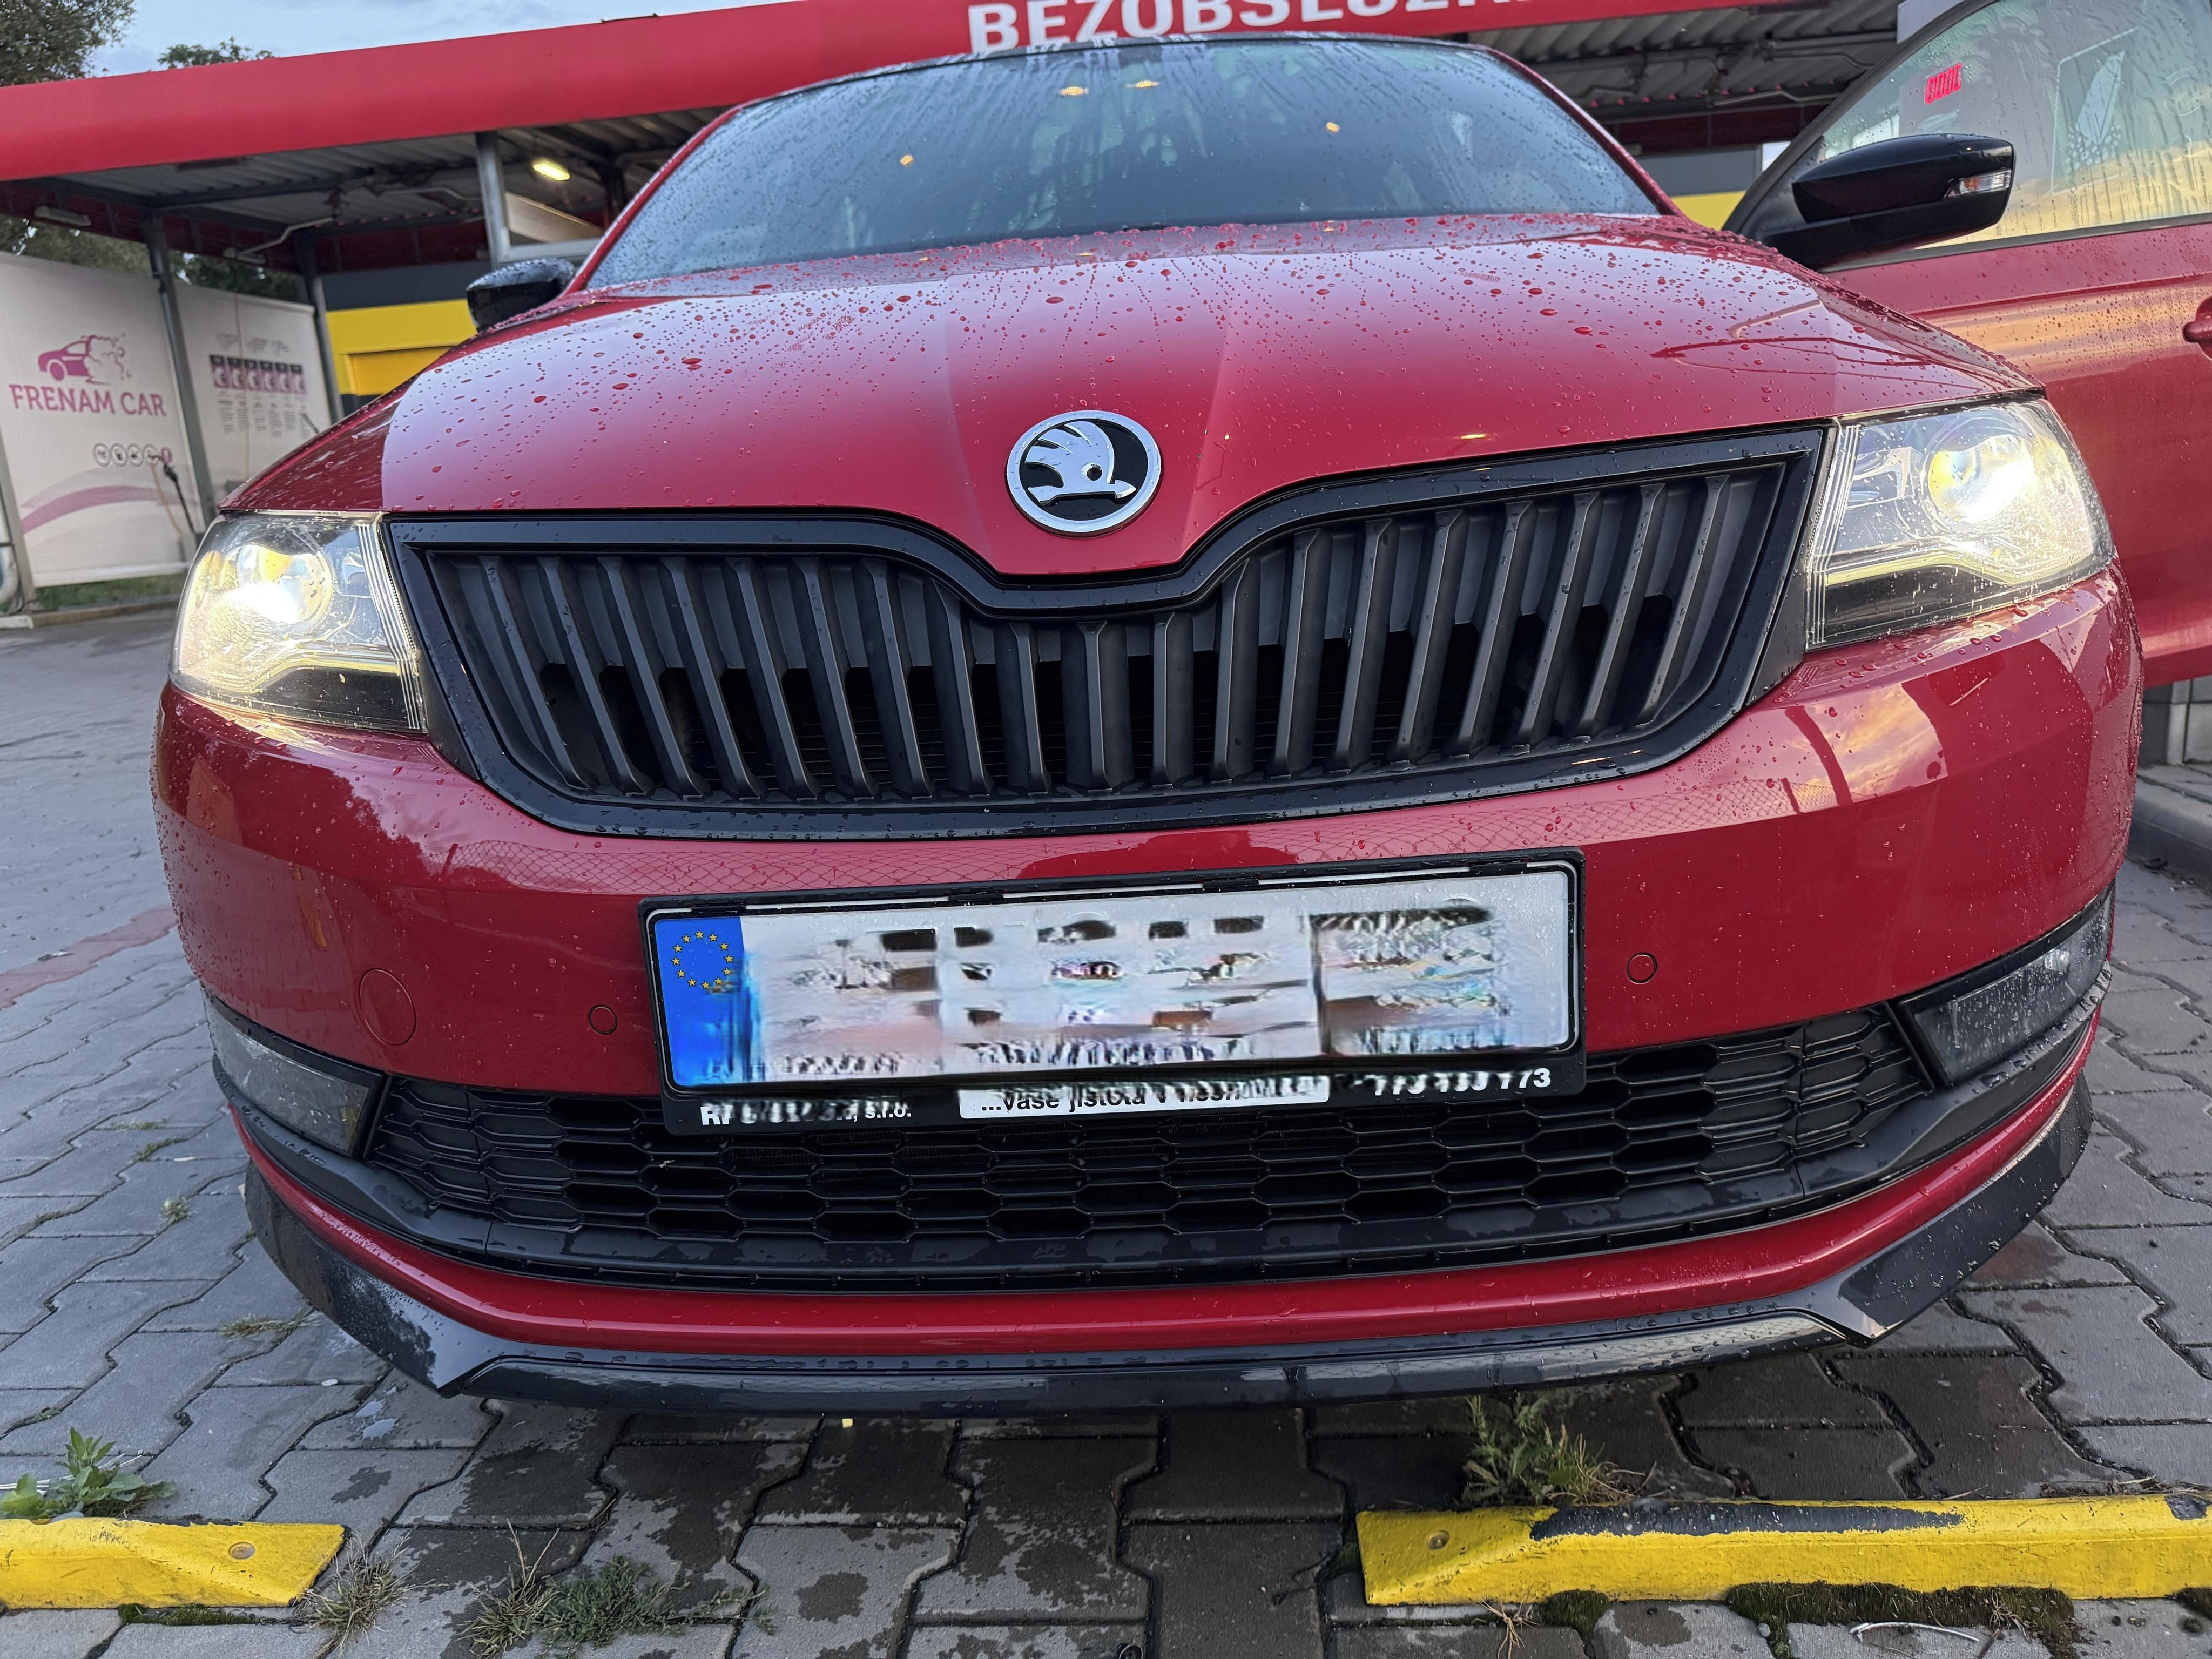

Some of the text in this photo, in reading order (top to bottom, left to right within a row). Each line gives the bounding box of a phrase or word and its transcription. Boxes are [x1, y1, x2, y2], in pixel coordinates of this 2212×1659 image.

[968, 0, 1528, 53] BEZOBS
[9, 384, 167, 417] FRENAM CAR
